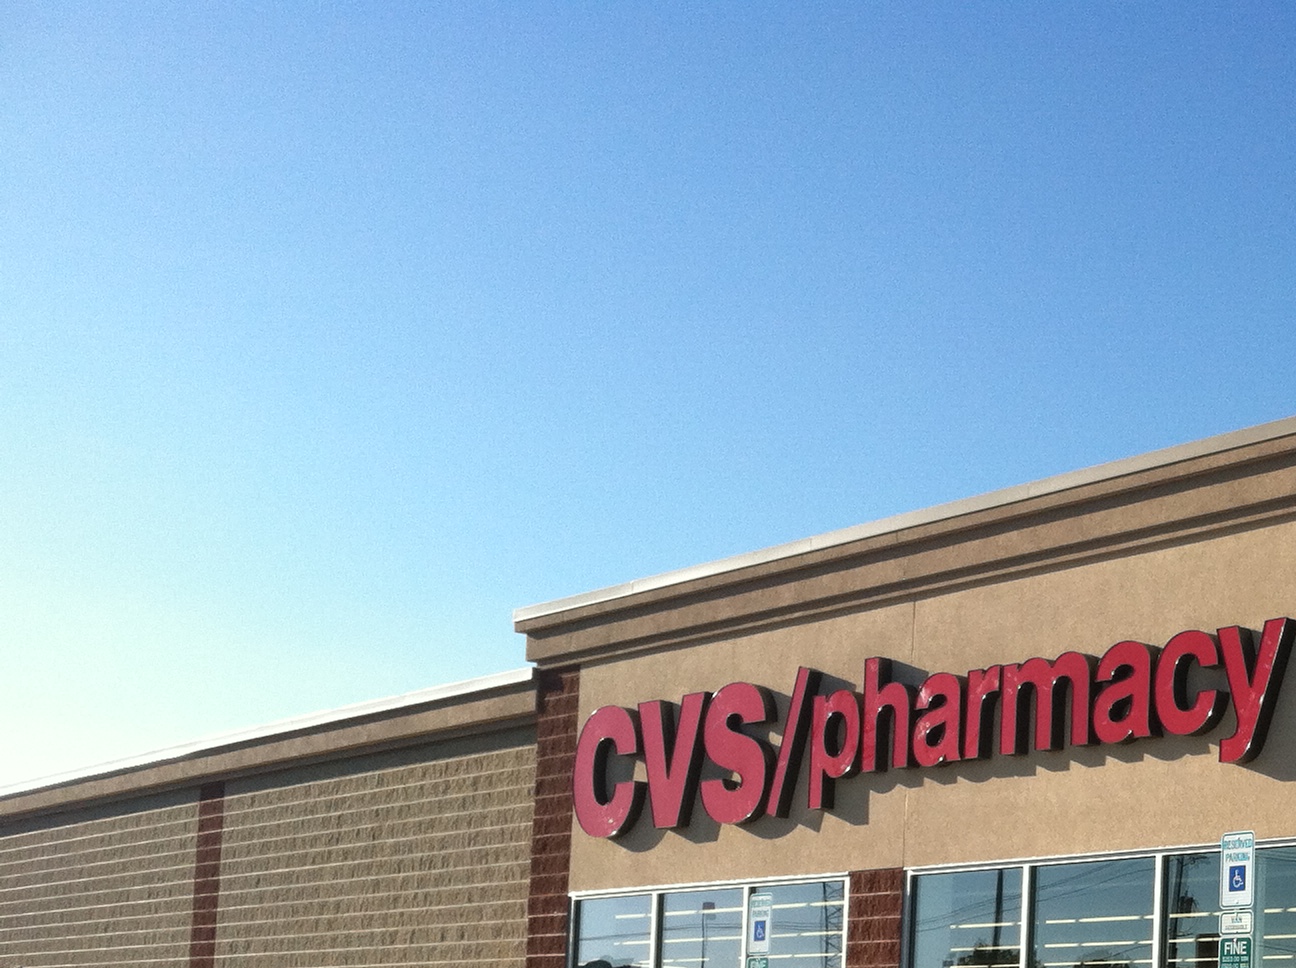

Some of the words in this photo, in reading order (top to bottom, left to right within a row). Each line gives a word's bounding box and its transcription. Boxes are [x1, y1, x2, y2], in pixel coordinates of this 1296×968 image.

[1223, 839, 1252, 849] RESERVED
[1225, 852, 1250, 862] PARKING
[1224, 941, 1247, 955] FINE
